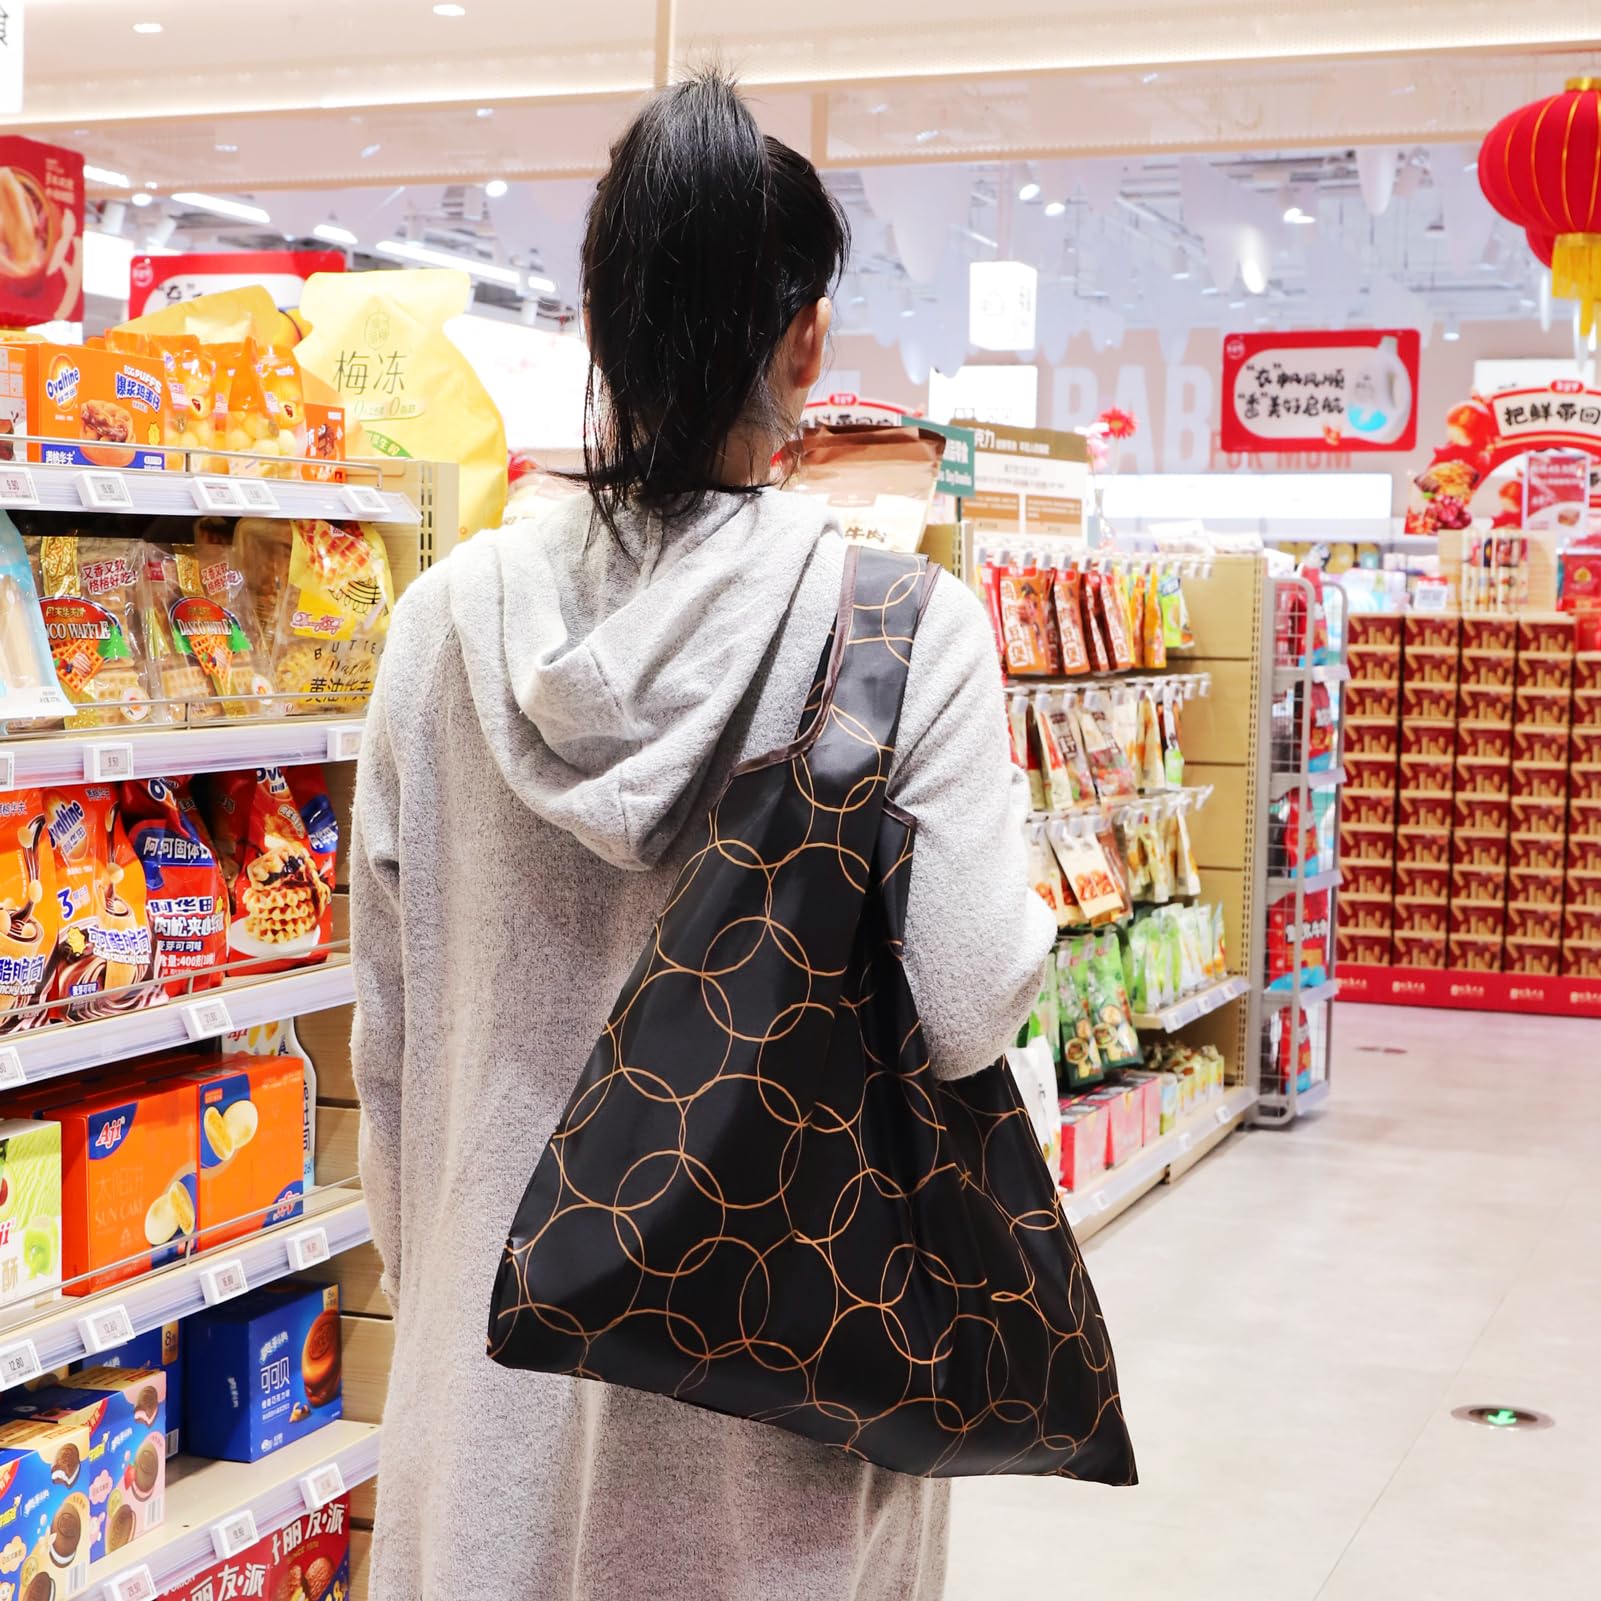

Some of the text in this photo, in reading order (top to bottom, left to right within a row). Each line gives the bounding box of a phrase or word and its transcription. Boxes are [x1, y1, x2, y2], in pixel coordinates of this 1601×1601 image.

[47, 368, 80, 399] Ovaltine
[333, 350, 407, 395] 梅冻
[1505, 402, 1601, 426] 把鲜带回
[82, 558, 126, 580] 又香又软
[201, 562, 228, 582] 又香又软
[88, 571, 138, 593] 格格好吃!
[67, 620, 112, 640] WAFFLE
[313, 639, 384, 660] BUTTE
[58, 889, 73, 919] 3
[150, 897, 213, 913] 阿华田
[95, 1118, 124, 1149] Aji
[8, 1356, 25, 1371] 12.80
[259, 1355, 291, 1395] 可可贝
